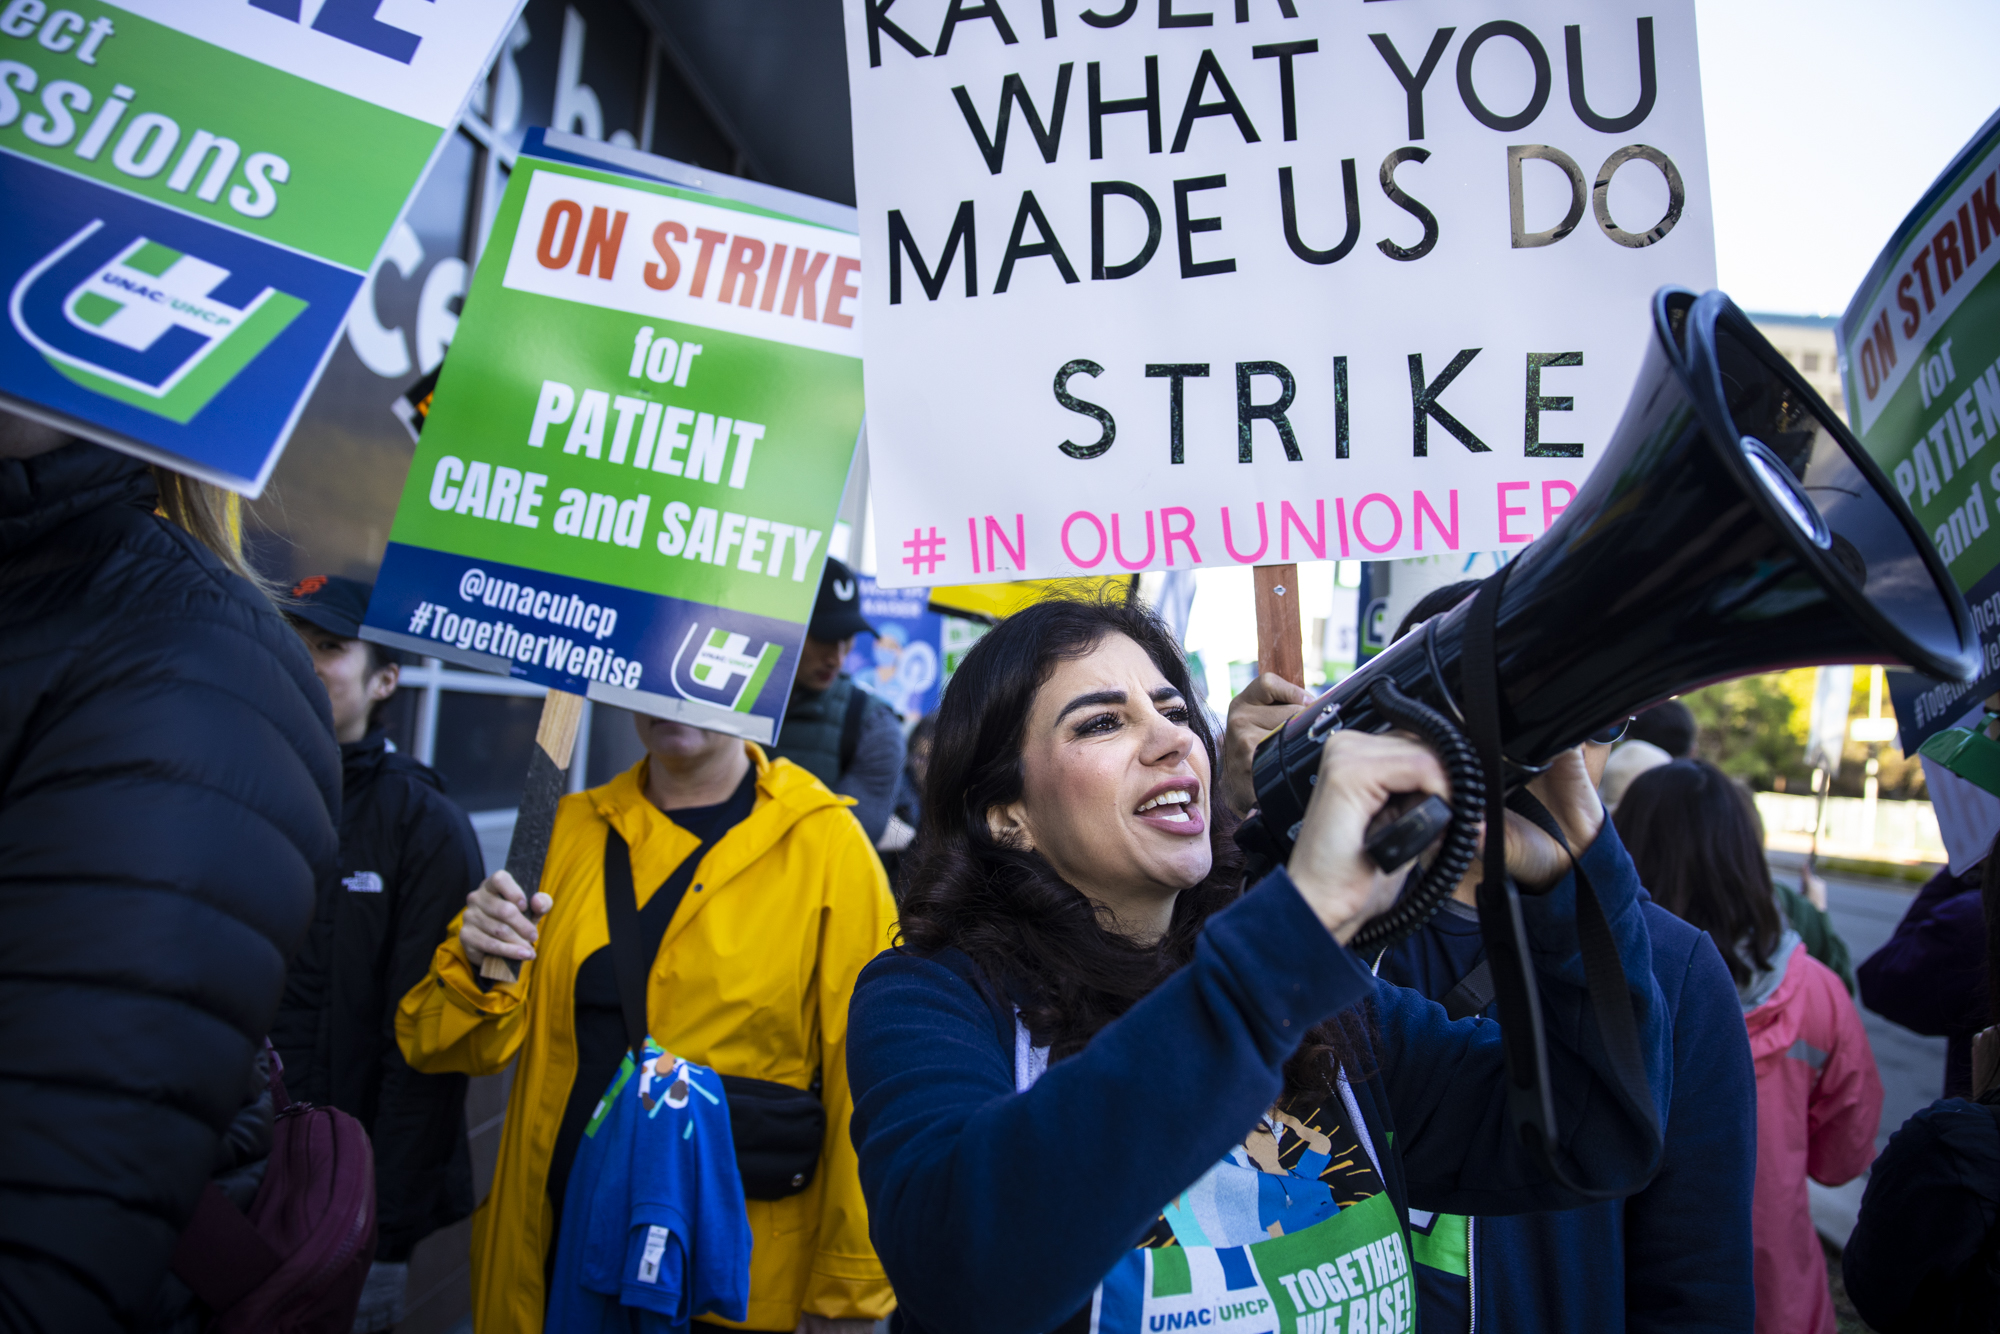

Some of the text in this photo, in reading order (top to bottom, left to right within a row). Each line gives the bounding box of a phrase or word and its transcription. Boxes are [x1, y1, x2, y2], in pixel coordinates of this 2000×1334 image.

[951, 39, 1318, 175] WHAT
[1368, 17, 1656, 140] YOU
[536, 199, 862, 329] ON STRIKE
[888, 144, 1684, 305] MADE US DO
[1861, 163, 2000, 402] ON STRIK
[628, 326, 703, 388] for
[1053, 348, 1584, 464] STRIKE
[1919, 336, 1956, 410] for
[527, 379, 766, 490] PATIENT
[1894, 354, 2000, 518] PATIEN
[429, 455, 822, 583] CARE and SAFETY
[902, 526, 946, 575] #
[968, 513, 1026, 574] IN
[1061, 506, 1203, 570] OUR
[1221, 489, 1459, 565] UNION
[1935, 480, 1990, 569] and
[407, 601, 643, 691] #TogetherWeRise
[459, 568, 618, 640] @unacuhcp
[1278, 1231, 1408, 1314] TOGETHER
[1296, 1276, 1411, 1334] WE RISE!
